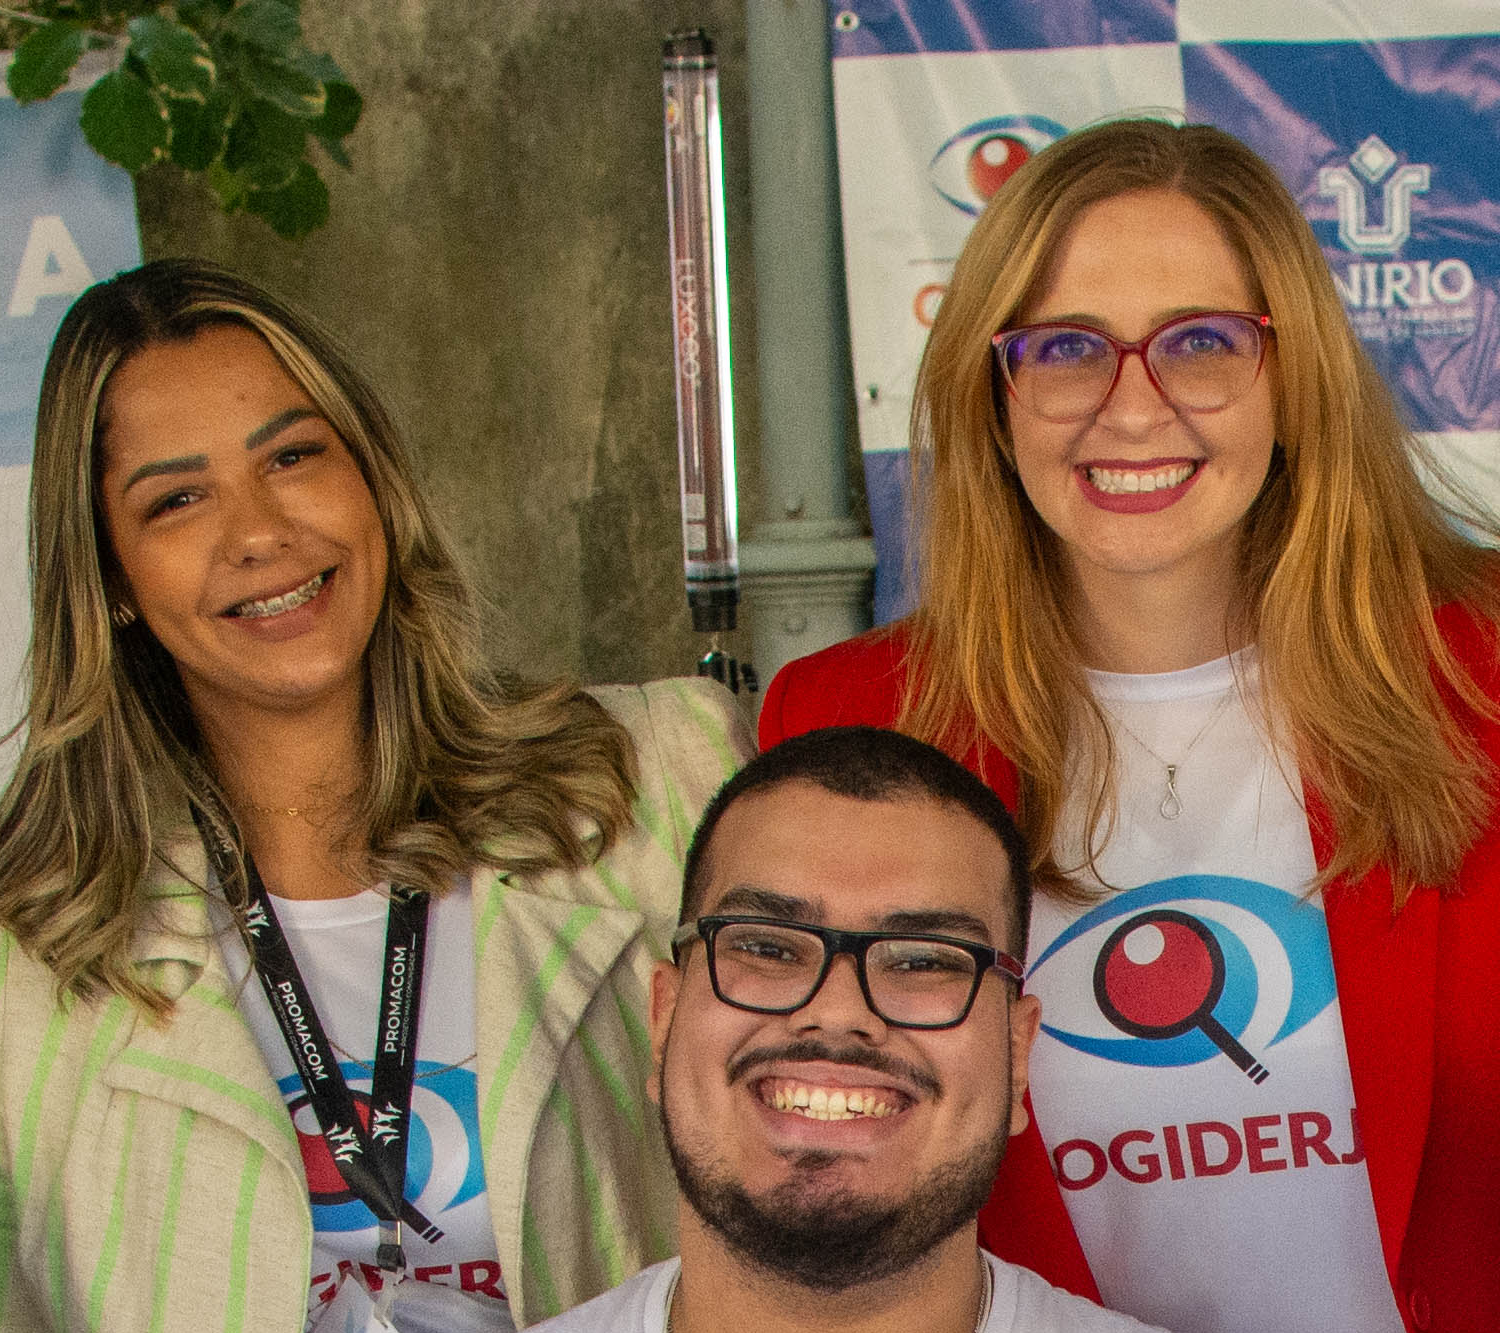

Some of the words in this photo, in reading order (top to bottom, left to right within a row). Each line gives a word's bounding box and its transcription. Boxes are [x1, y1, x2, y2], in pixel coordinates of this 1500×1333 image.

[278, 981, 329, 1081] PROMACOM
[385, 947, 407, 1052] PROMACOM
[1050, 1107, 1365, 1192] OGIDERJ
